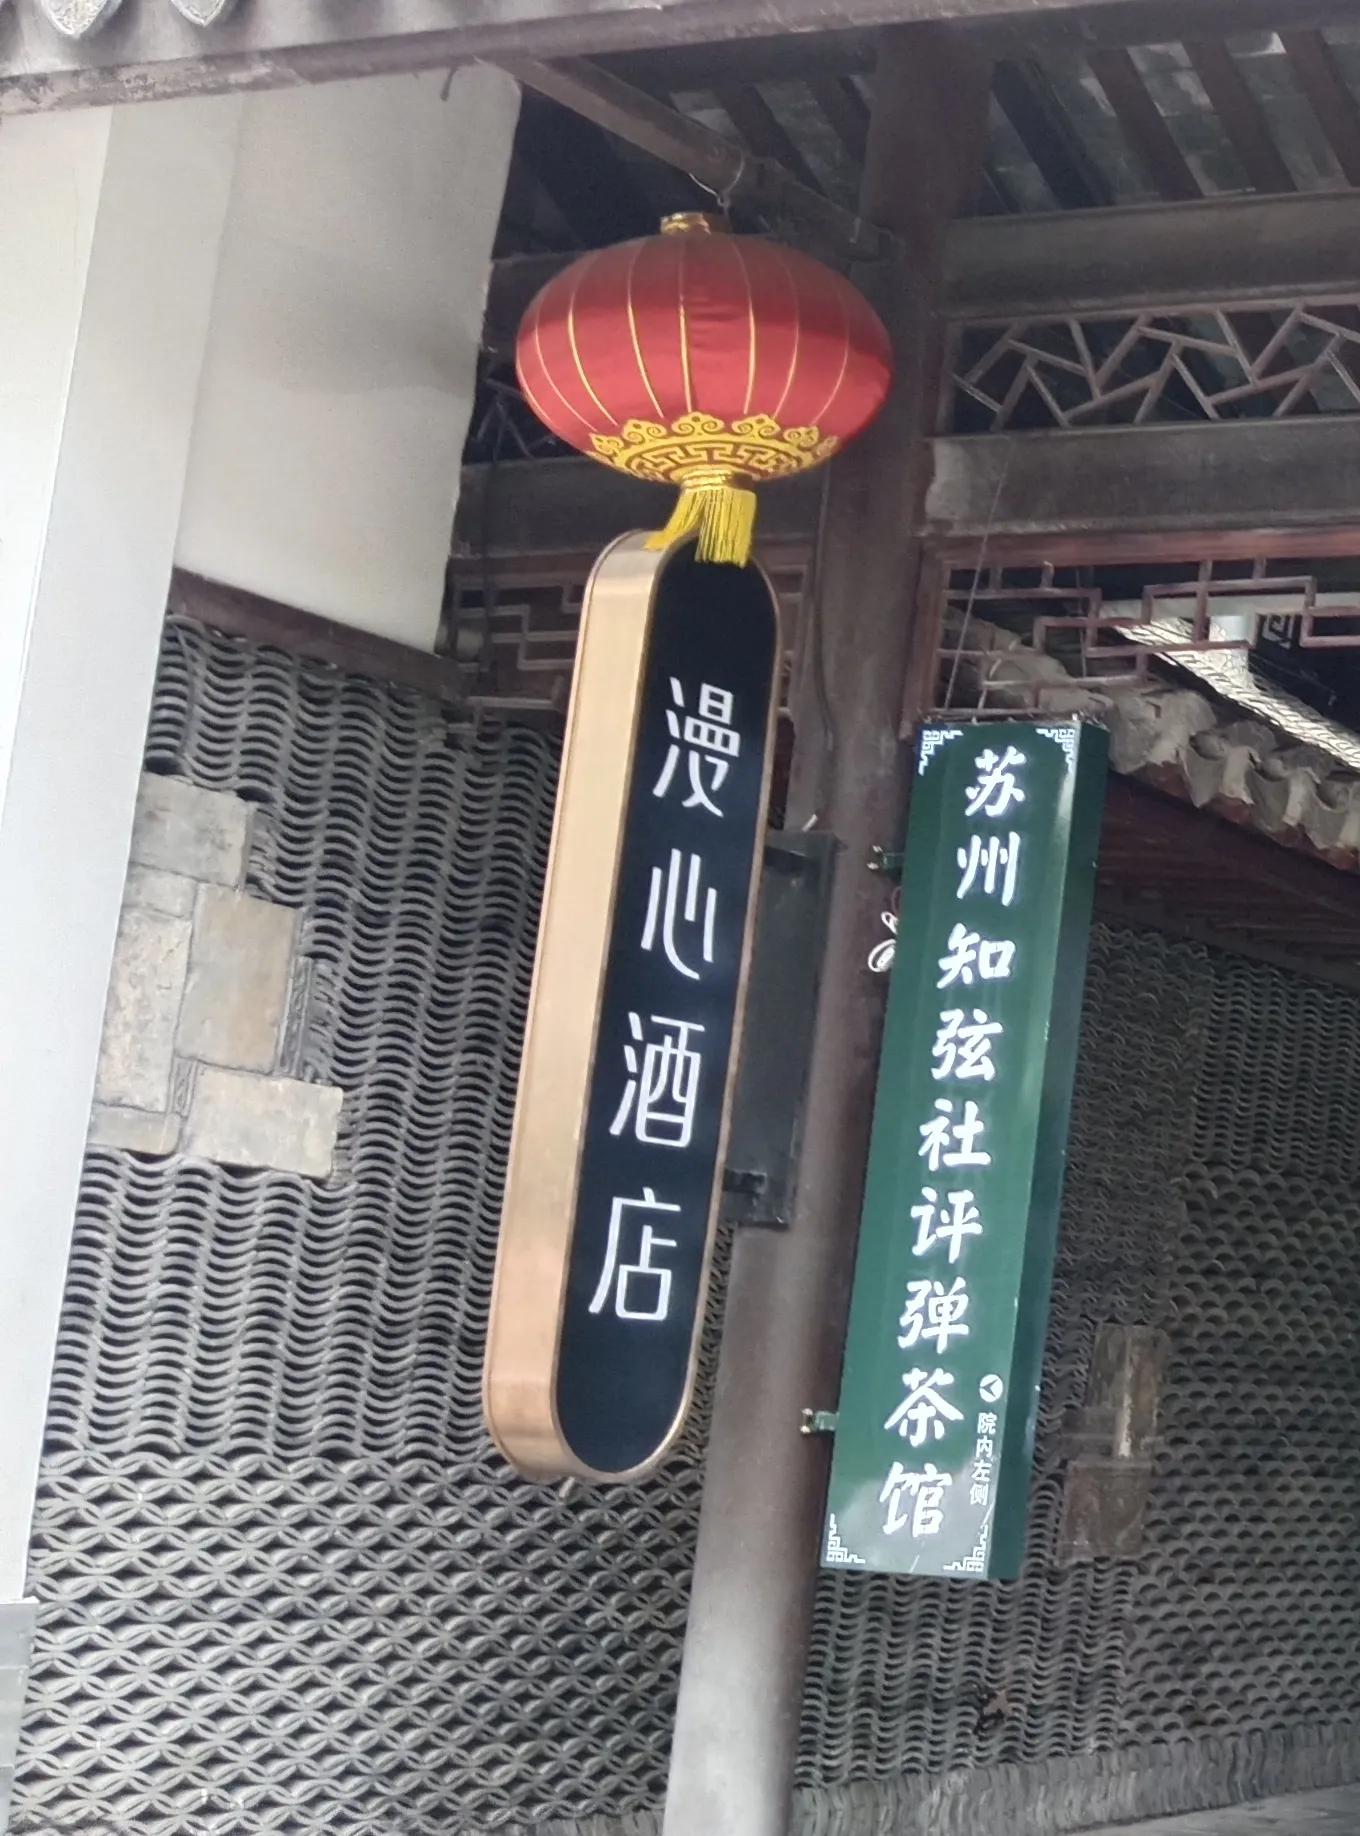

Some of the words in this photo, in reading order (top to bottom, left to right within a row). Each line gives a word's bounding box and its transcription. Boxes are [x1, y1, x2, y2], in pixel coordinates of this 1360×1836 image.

[587, 677, 740, 1321] 漫心酒店
[879, 746, 1026, 1537] 苏州知弦社评弹茶馆
[969, 1411, 998, 1507] 院内左侧
